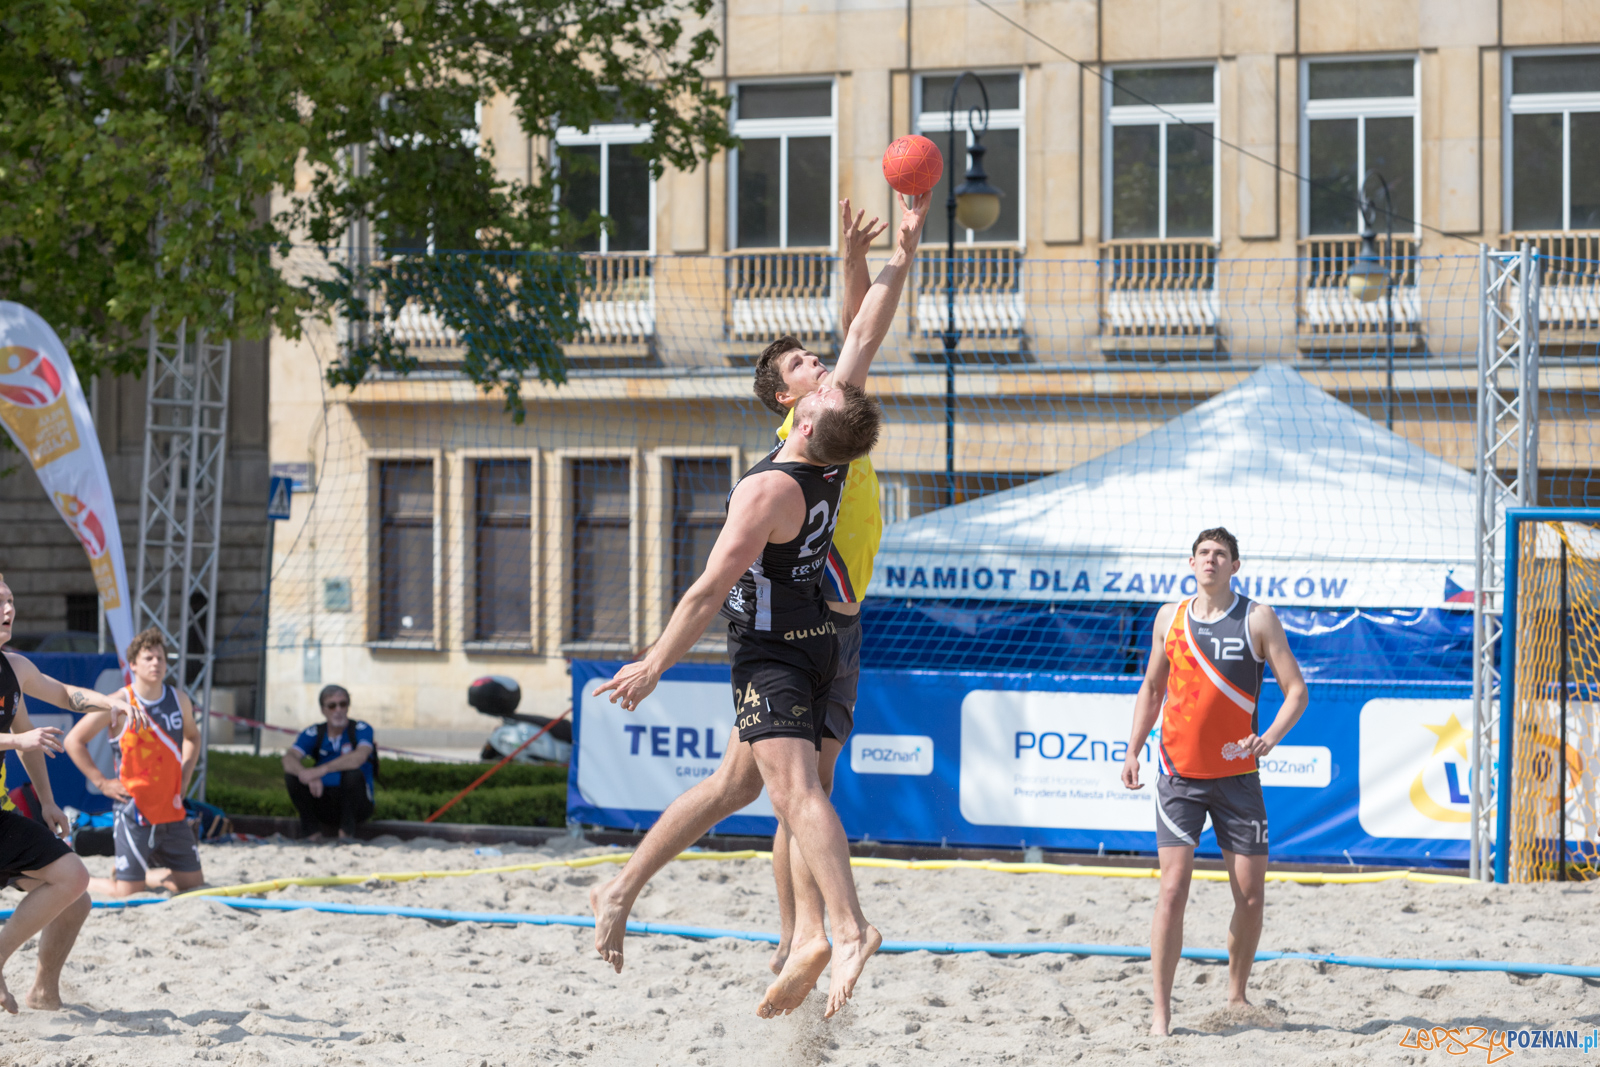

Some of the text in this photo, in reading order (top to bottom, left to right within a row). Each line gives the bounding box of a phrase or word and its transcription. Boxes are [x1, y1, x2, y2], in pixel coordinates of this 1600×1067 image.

[886, 566, 1348, 599] NAMIOT DLA ZAWONIKÓW
[1210, 637, 1245, 661] 12
[735, 681, 761, 716] 24
[161, 711, 182, 731] 16
[739, 711, 762, 731] OCK
[1069, 789, 1104, 800] Miasta
